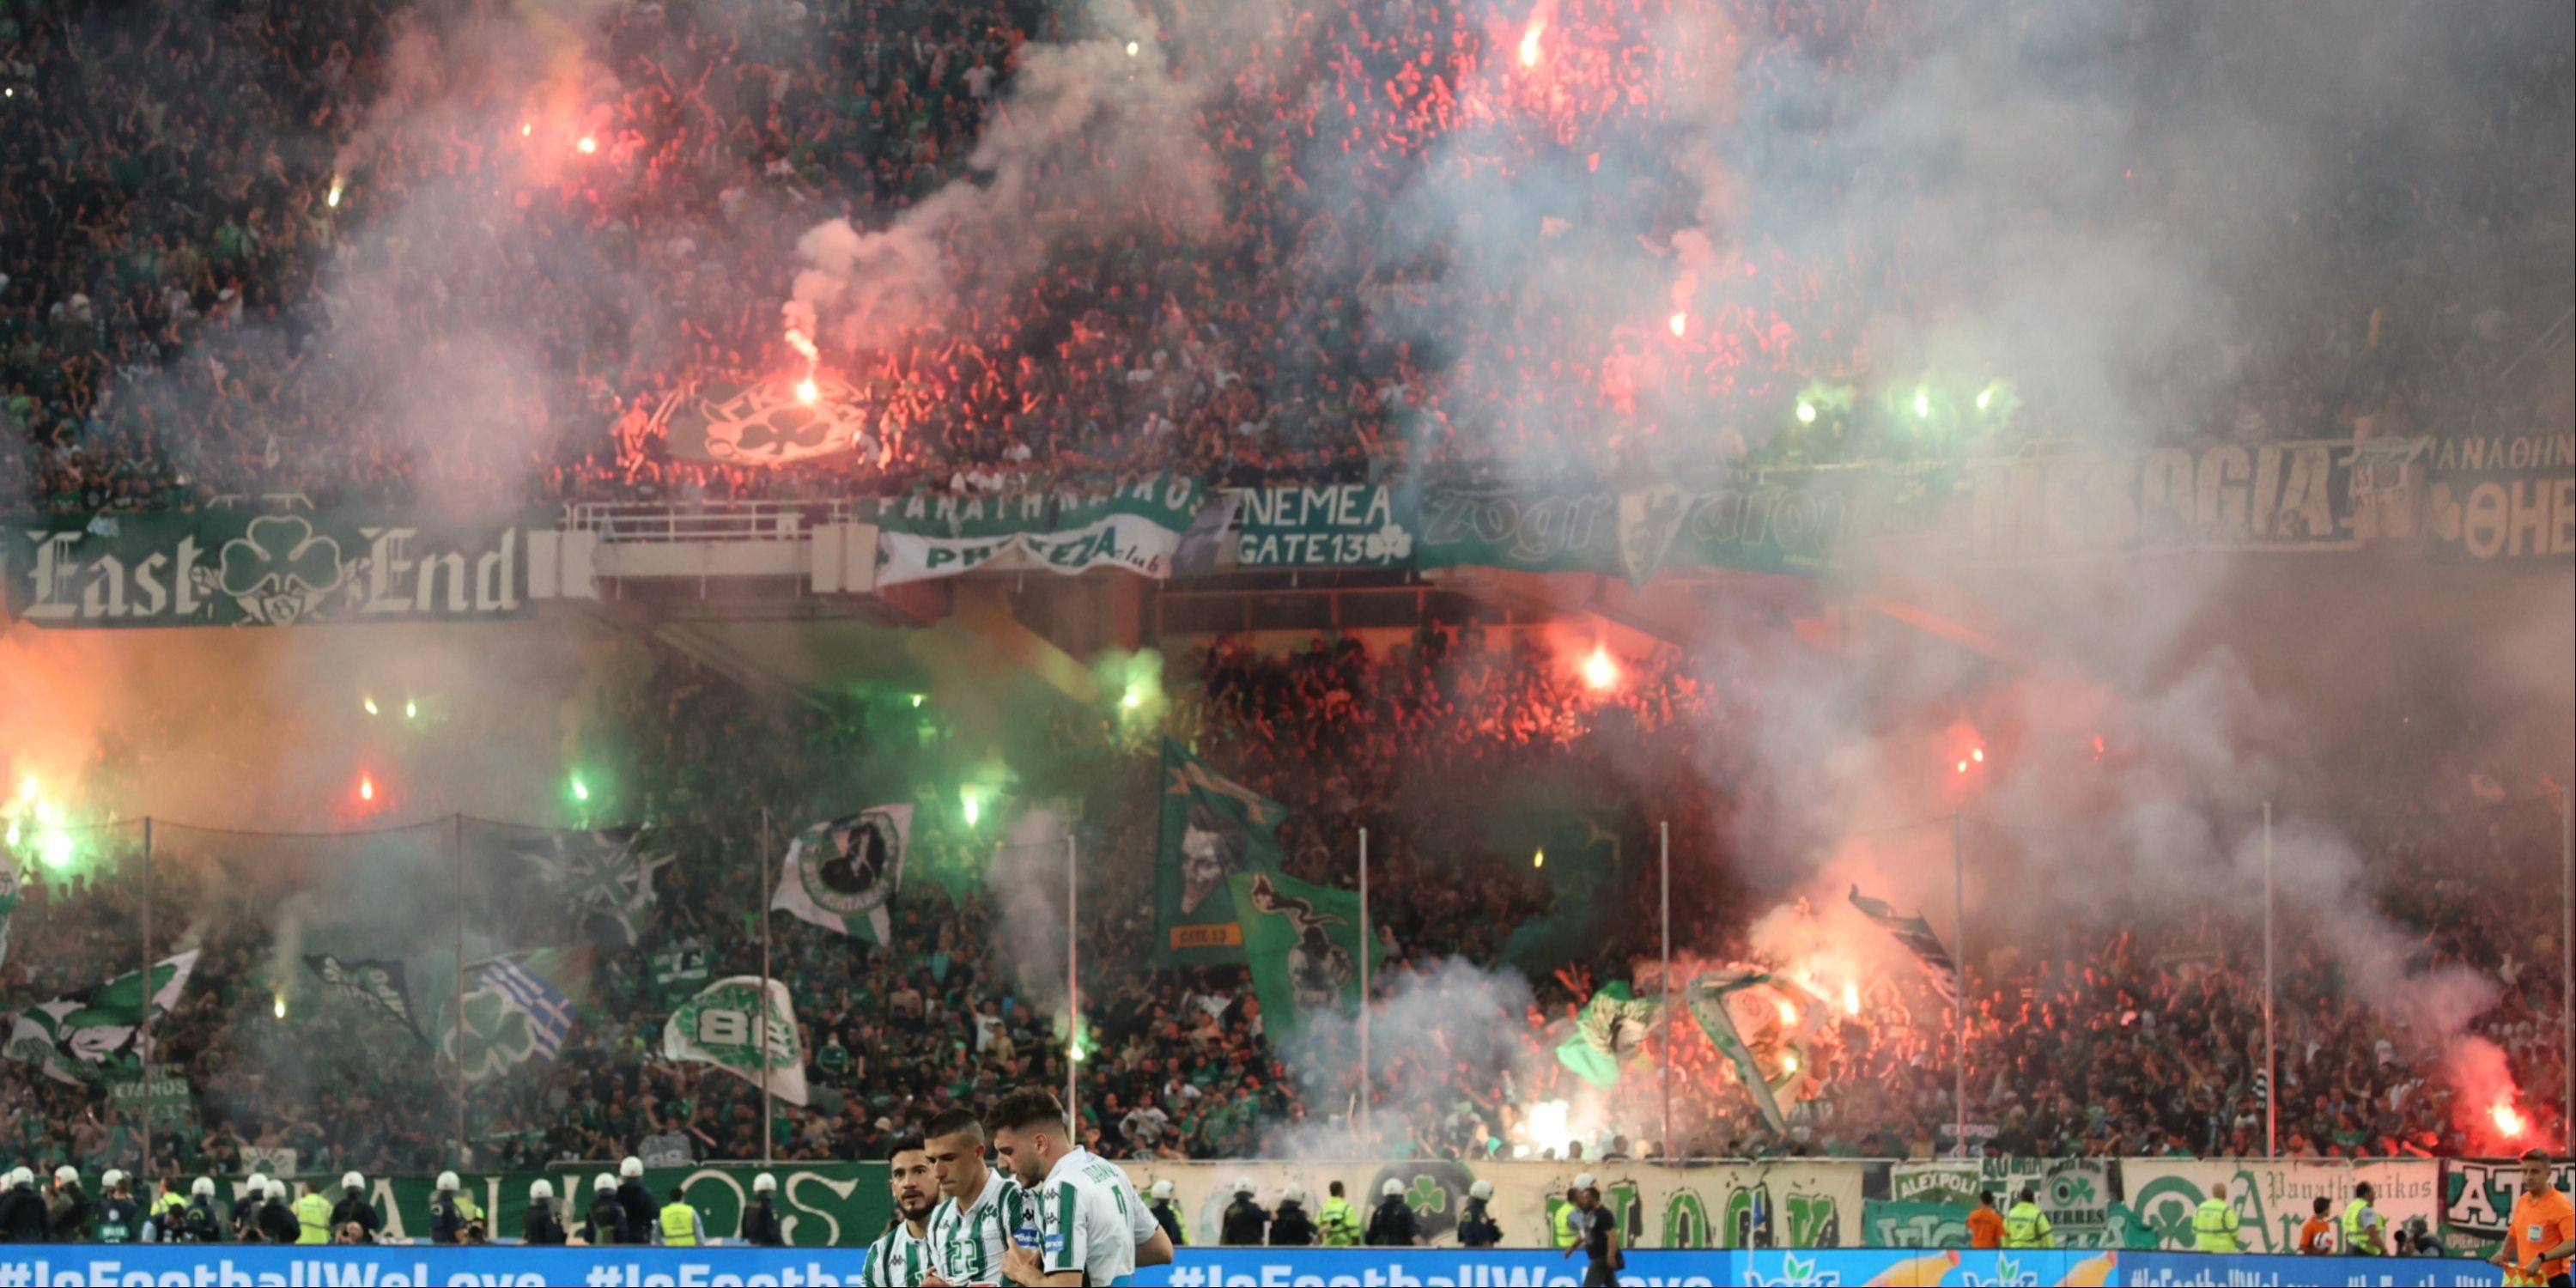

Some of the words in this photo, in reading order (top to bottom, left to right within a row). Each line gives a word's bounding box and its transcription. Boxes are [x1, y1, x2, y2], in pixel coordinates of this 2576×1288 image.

[1242, 483, 1392, 526] NEMEA
[21, 529, 204, 618] East
[356, 526, 520, 612] End
[2267, 1170, 2432, 1207] Panathiaikos
[950, 1239, 979, 1275] 22
